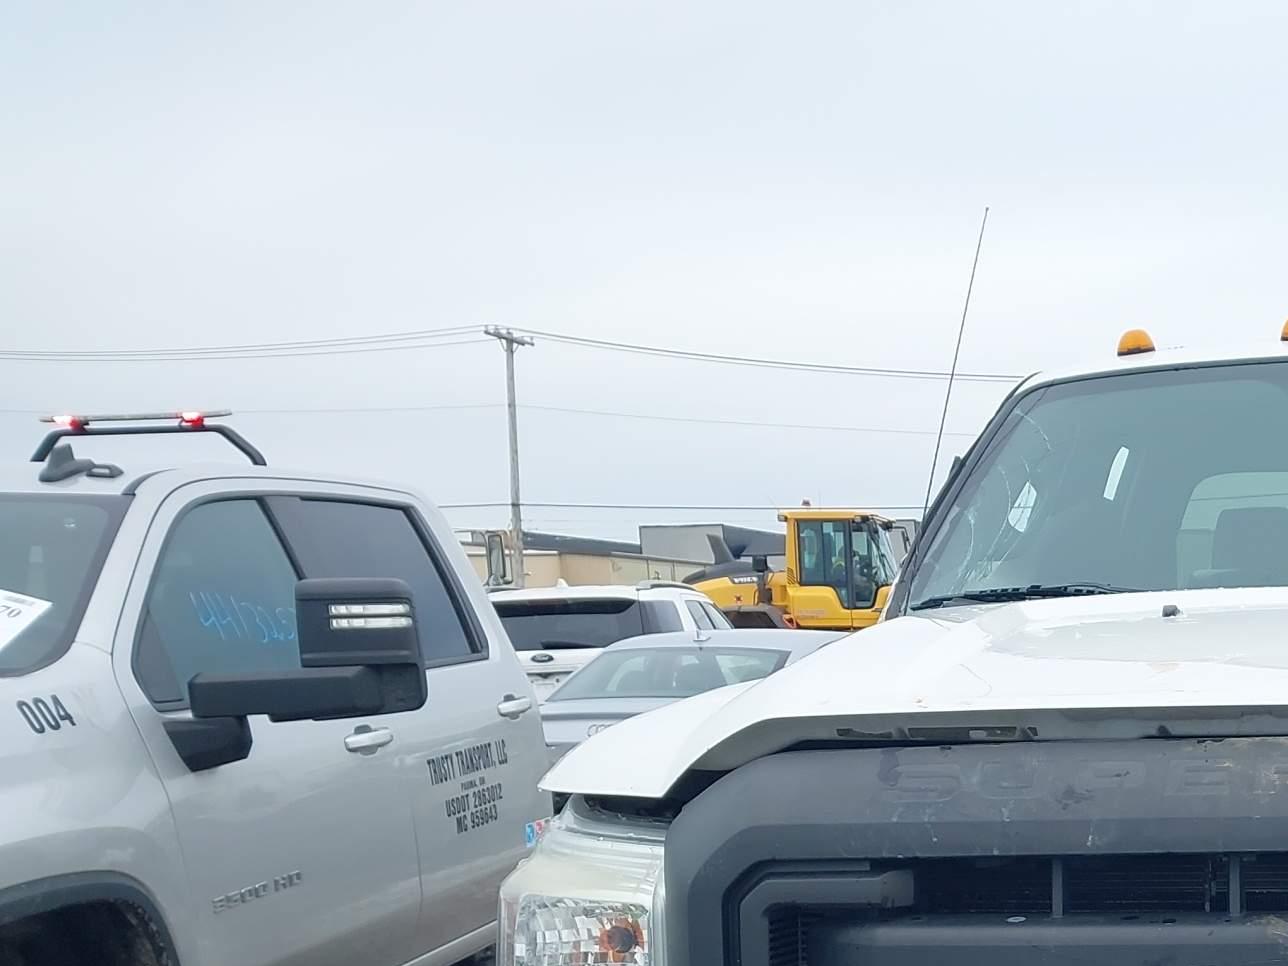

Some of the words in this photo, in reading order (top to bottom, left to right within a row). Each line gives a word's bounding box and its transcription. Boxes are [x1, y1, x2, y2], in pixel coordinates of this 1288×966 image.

[16, 694, 77, 734] 004
[427, 753, 456, 786] TRUSTY
[455, 742, 497, 777] TRANSPORT,
[494, 738, 508, 765] LLC
[445, 793, 471, 818] USDOT
[472, 782, 504, 809] 2863012
[456, 814, 469, 834] MC
[470, 803, 498, 829] 959643
[273, 871, 302, 892] HD
